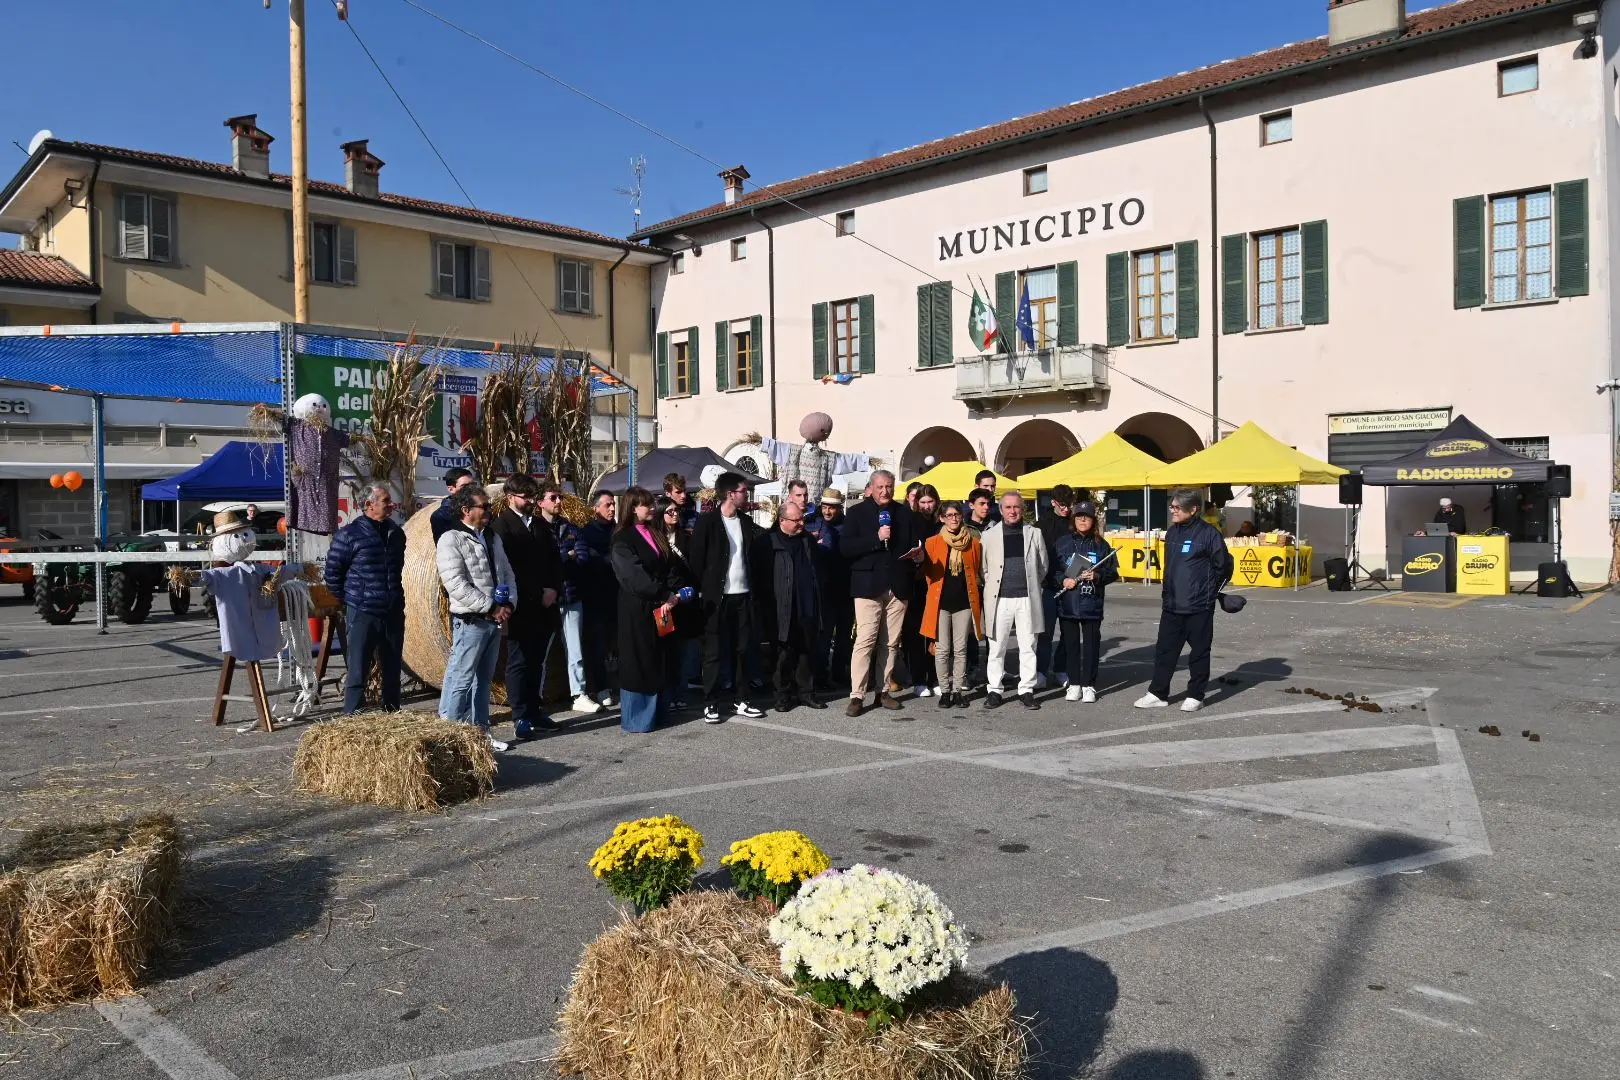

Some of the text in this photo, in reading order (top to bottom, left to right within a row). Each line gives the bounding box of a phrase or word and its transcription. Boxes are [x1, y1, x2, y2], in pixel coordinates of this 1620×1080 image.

[938, 197, 1145, 261] MUNICIPIO
[334, 366, 390, 391] PALO
[337, 393, 373, 411] dell
[1342, 416, 1370, 424] COMUNE
[1401, 413, 1414, 421] SAN
[1415, 412, 1448, 420] GIACOMO
[1356, 421, 1433, 431] Informazioni municipali
[1397, 467, 1513, 481] RADIOBRUNO
[1267, 555, 1308, 579] GRANA
[1407, 562, 1439, 570] BRUNO
